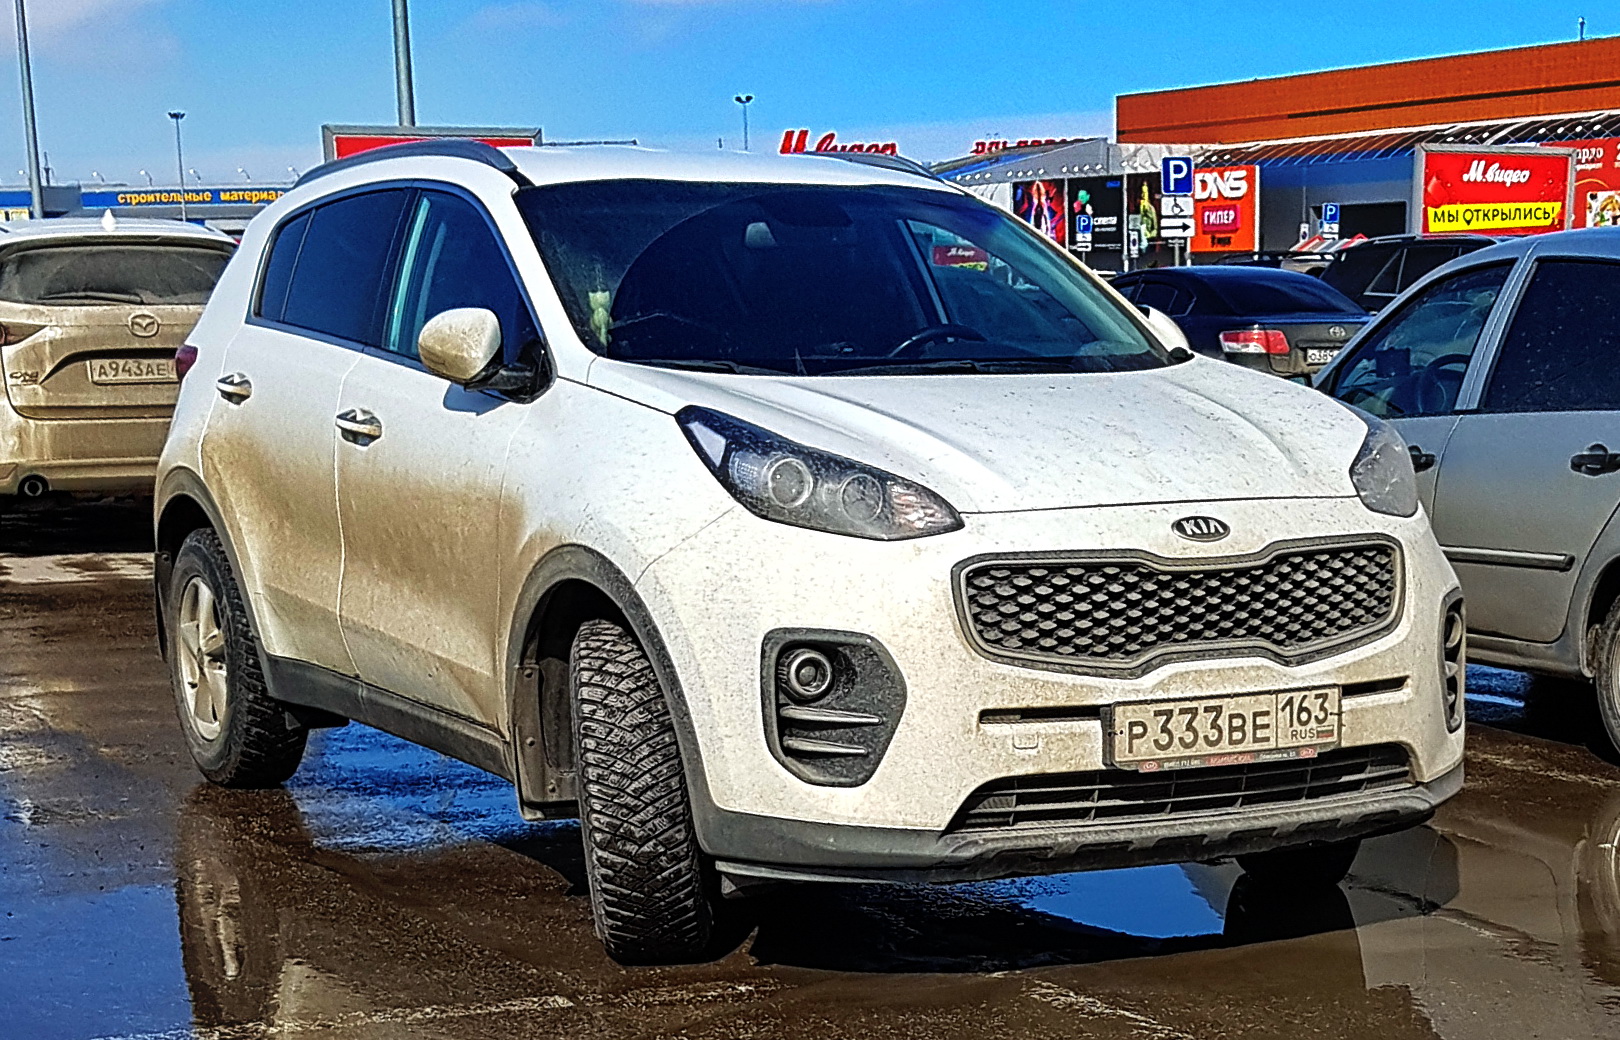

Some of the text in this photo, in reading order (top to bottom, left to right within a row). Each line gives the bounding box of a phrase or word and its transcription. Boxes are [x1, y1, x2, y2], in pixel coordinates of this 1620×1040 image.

[1169, 160, 1188, 191] P
[1462, 160, 1531, 187] М.видео
[1194, 170, 1248, 200] DNS
[117, 190, 212, 206] строительные
[1203, 209, 1236, 225] ГИПЕР
[1433, 206, 1556, 226] МЫ ОТКРЫЛИСЬ!
[1181, 518, 1225, 535] KIA
[1127, 692, 1329, 754] Р333ВЕ 163
[1290, 728, 1316, 741] RUS
